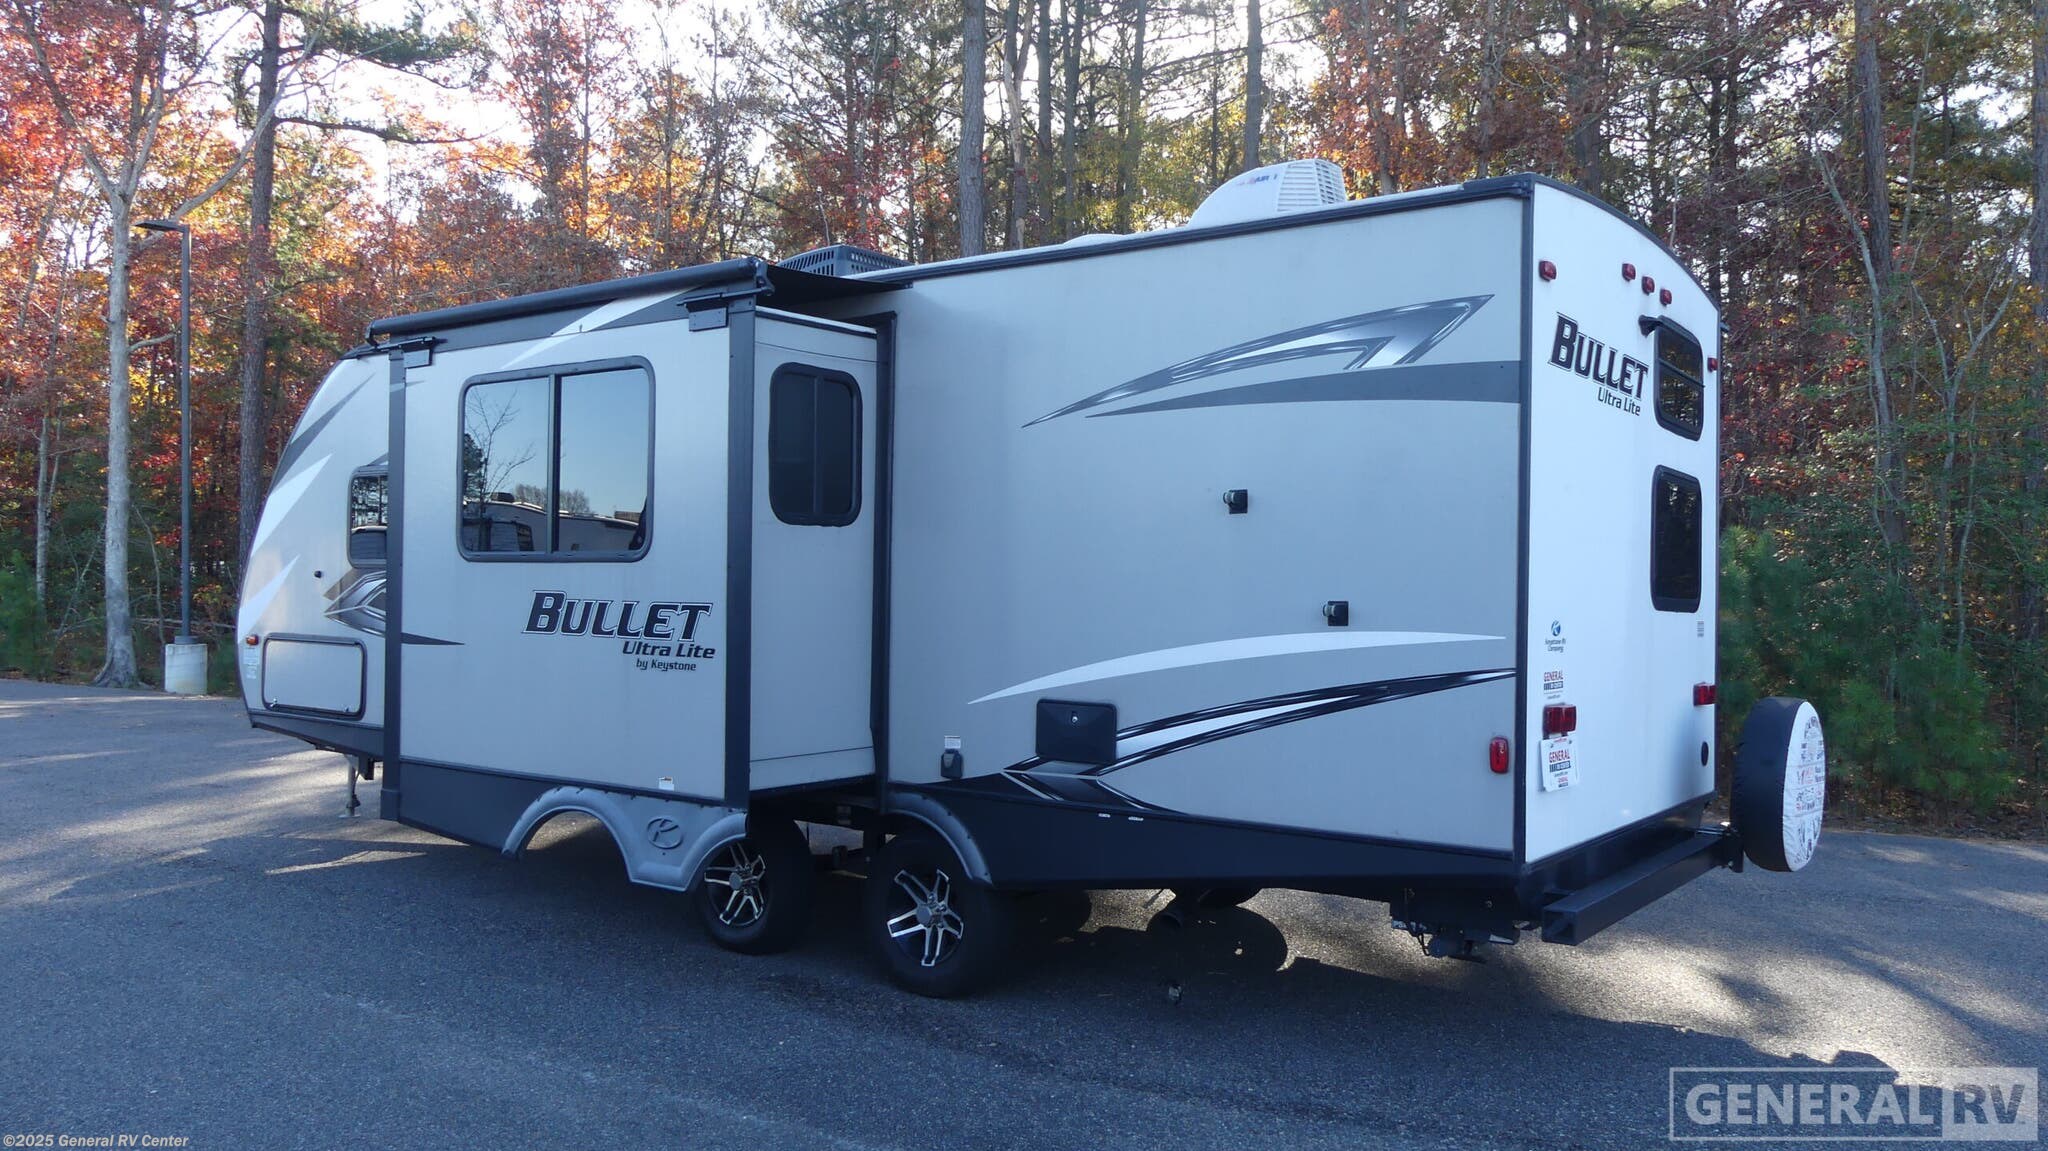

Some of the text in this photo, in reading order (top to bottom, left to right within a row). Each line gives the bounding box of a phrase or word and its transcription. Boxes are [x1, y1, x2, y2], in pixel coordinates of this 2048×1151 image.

[1547, 311, 1650, 401] BULLET
[1597, 387, 1641, 416] Ultra Lite
[521, 589, 714, 642] BULLET
[622, 640, 716, 659] Ultra Lite
[636, 658, 696, 672] by Keystone
[1544, 671, 1563, 682] GENERAL
[1549, 750, 1570, 763] GENERAL
